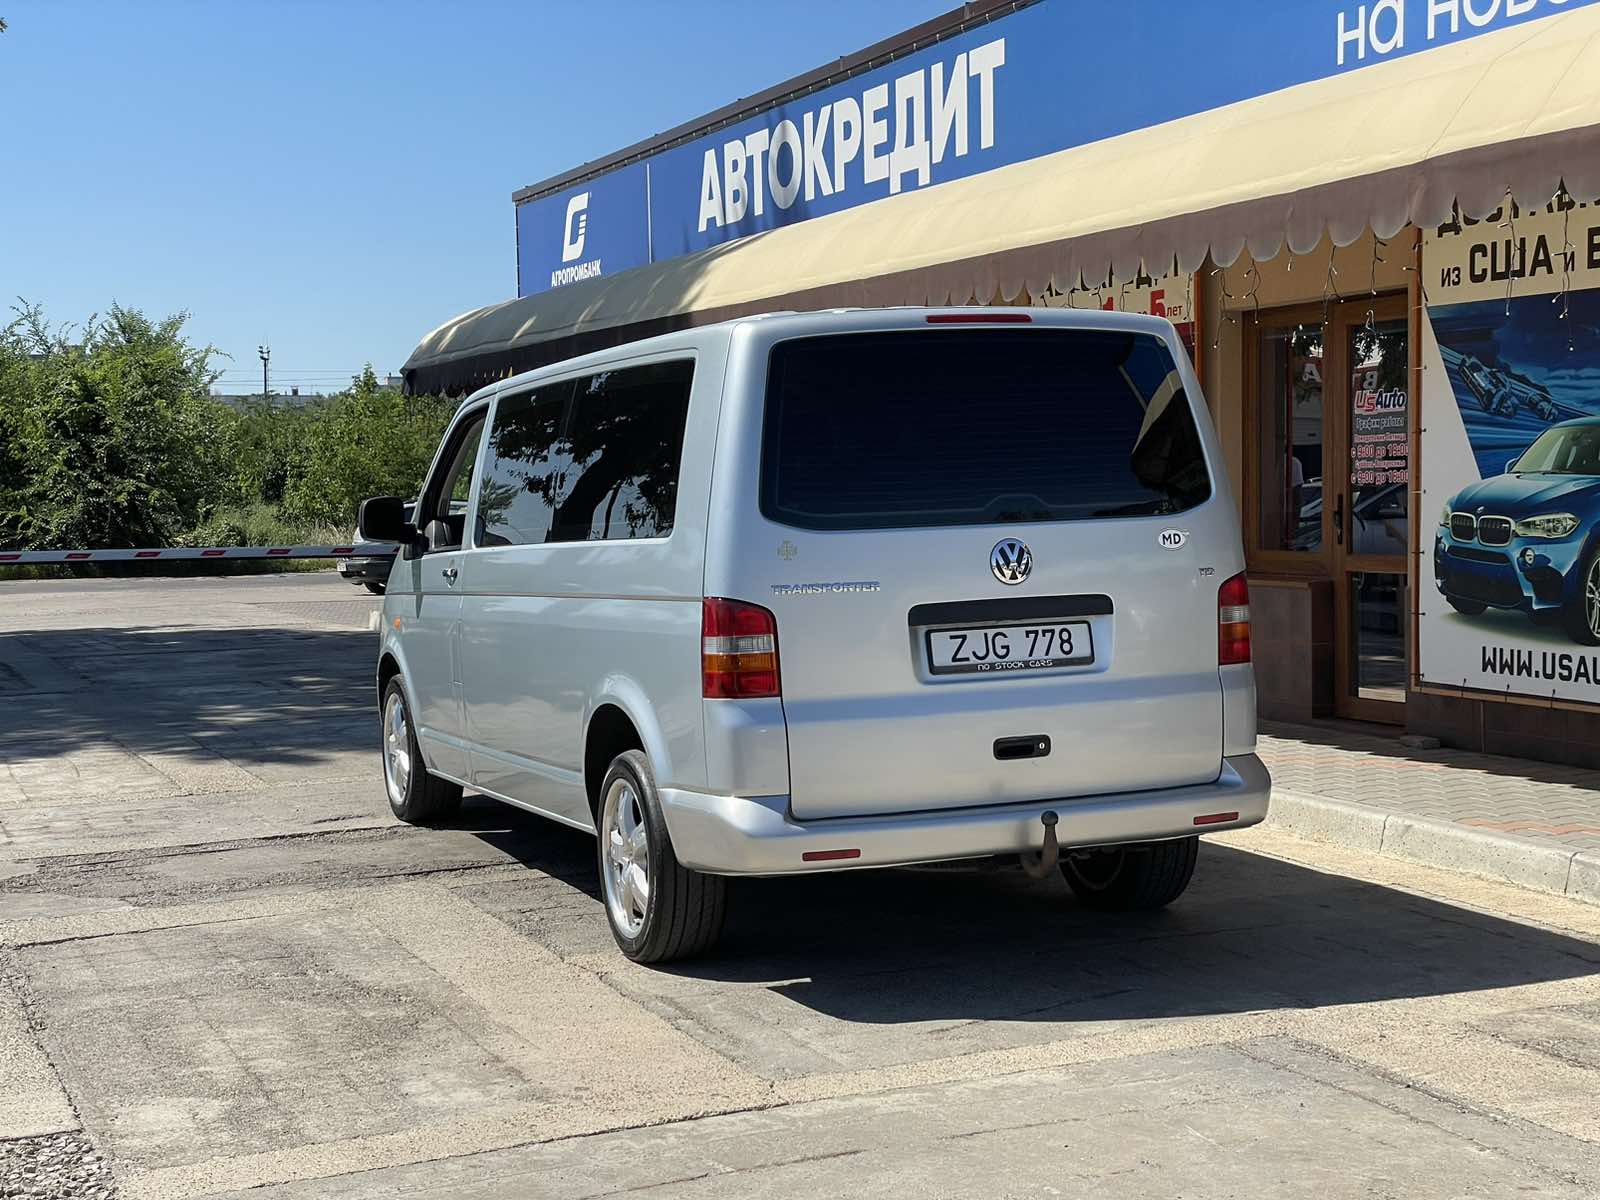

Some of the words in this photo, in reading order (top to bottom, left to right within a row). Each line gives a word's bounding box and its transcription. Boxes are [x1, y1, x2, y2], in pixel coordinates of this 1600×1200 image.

[698, 38, 1005, 232] АВТОКРЕДИТ
[1440, 266, 1462, 288] из
[1469, 234, 1554, 284] США
[551, 258, 602, 287] АГРОПРОМБАНК
[1166, 305, 1182, 317] лет
[1161, 532, 1182, 546] MD
[771, 581, 881, 596] TRANSPORTER
[949, 631, 1011, 662] ZJG
[1025, 627, 1074, 657] 778
[995, 660, 1025, 670] STOCK
[1029, 659, 1054, 668] CARS
